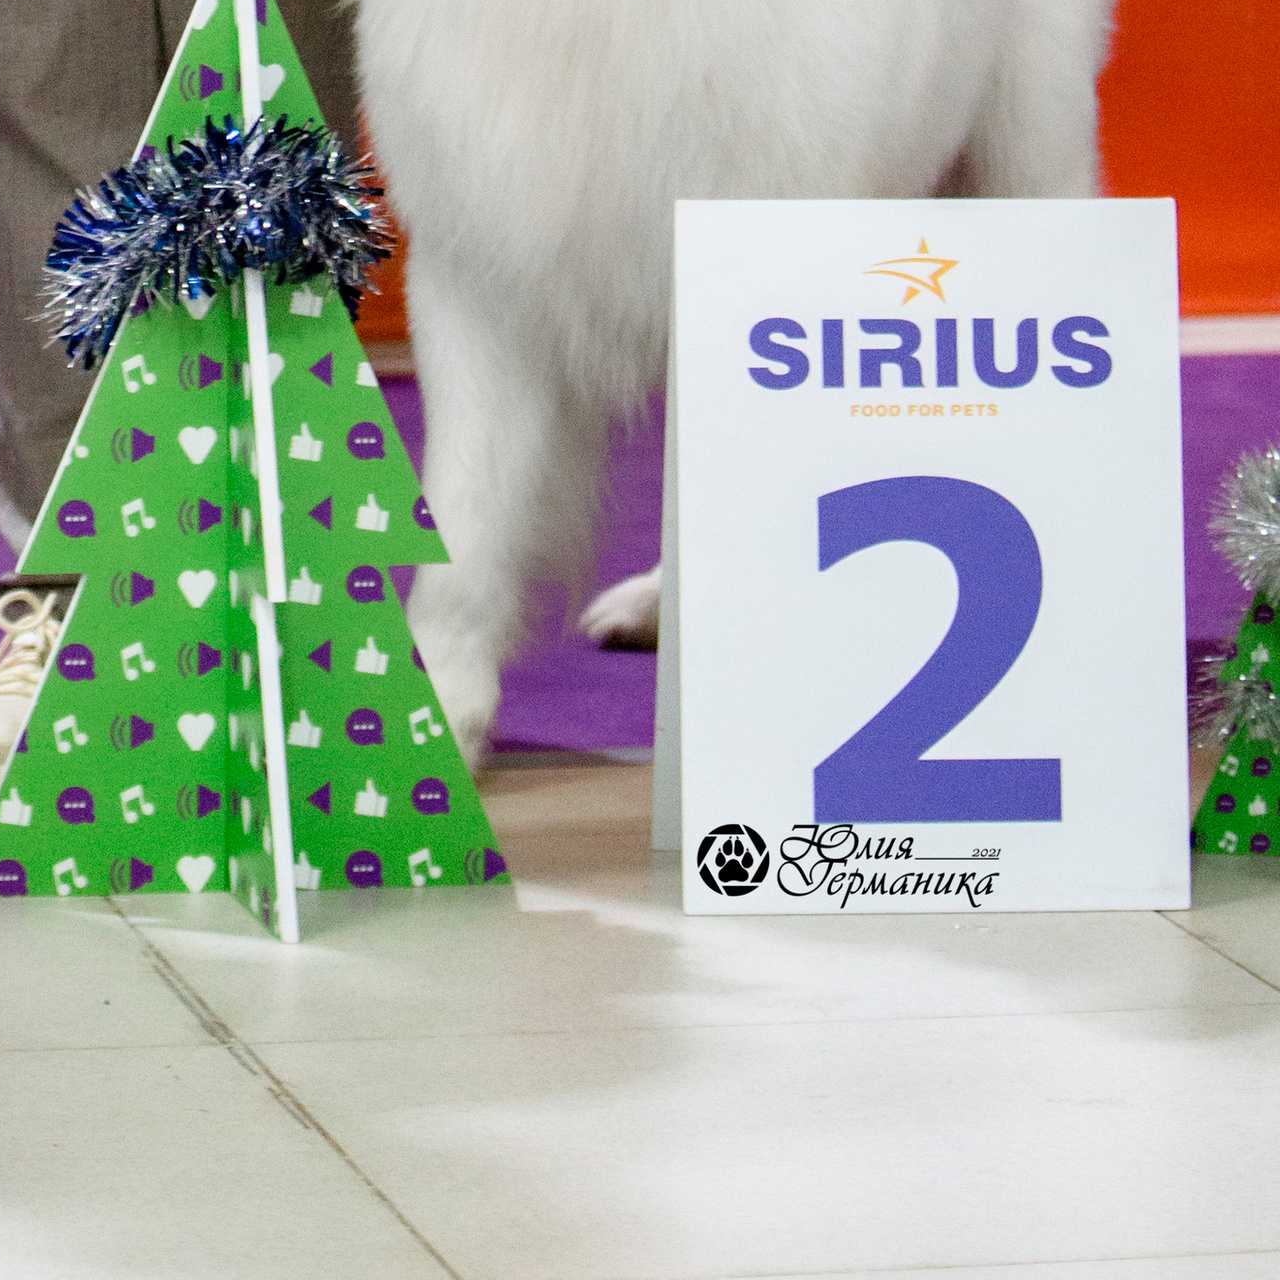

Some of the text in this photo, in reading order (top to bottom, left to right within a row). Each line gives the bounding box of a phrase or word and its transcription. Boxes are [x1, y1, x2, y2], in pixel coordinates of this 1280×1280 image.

[747, 315, 1113, 390] SIRIUS
[851, 404, 999, 417] FOOD FOR PETS
[812, 475, 1063, 824] 2
